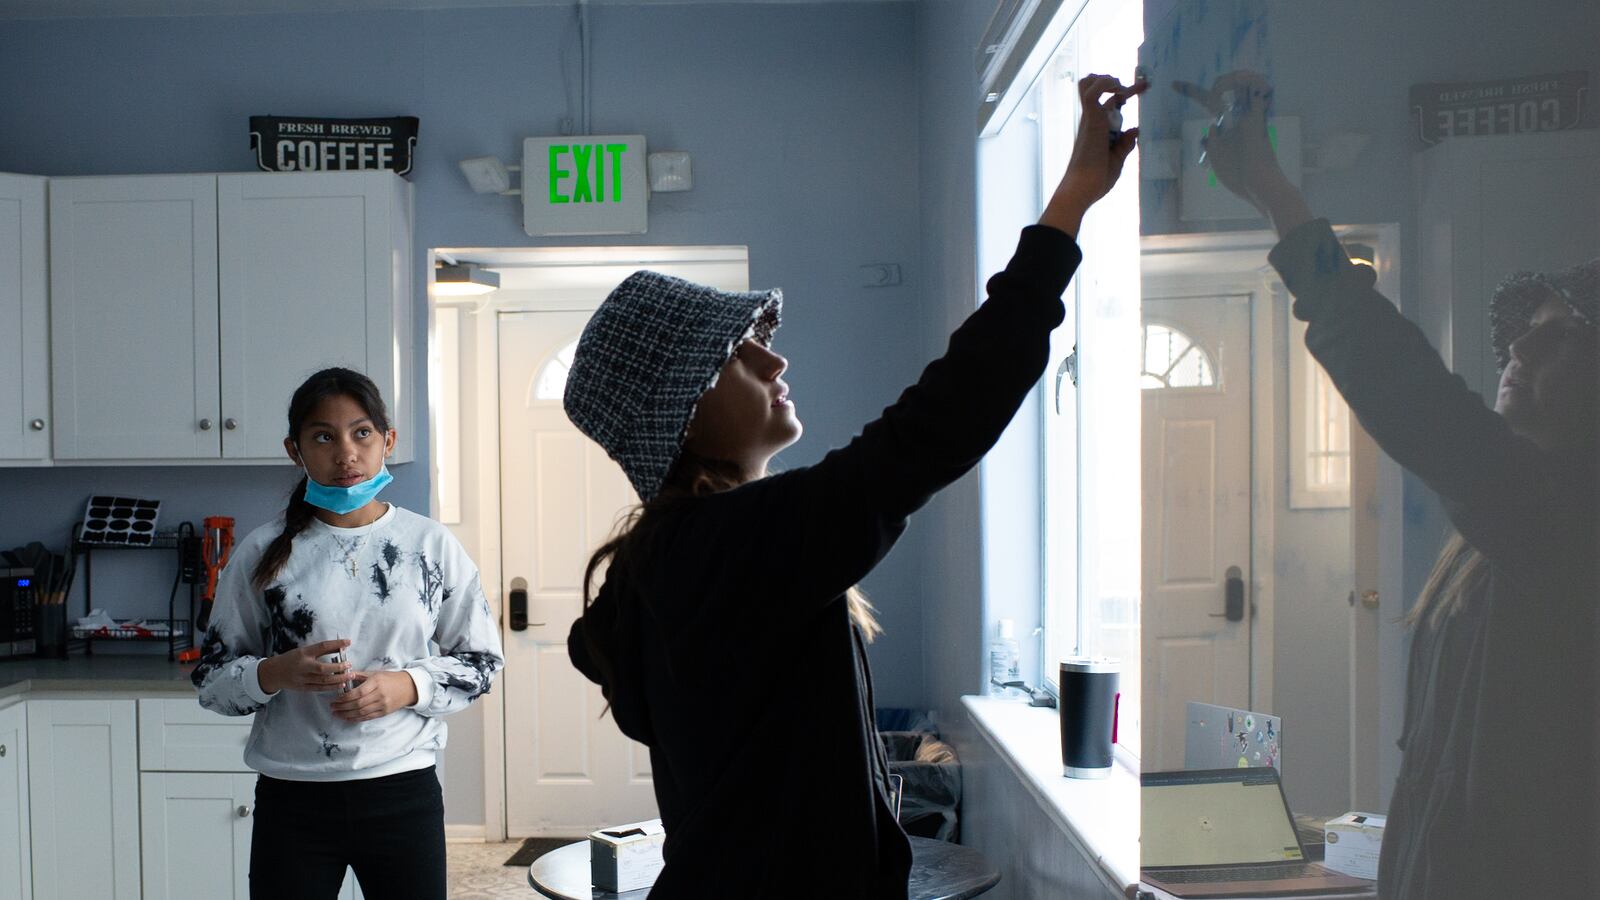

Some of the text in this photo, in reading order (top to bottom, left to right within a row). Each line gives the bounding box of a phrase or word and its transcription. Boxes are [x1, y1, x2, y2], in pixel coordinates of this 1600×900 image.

[278, 122, 392, 135] FRESH BREWED
[276, 139, 394, 171] COFFEE
[548, 143, 628, 204] EXIT
